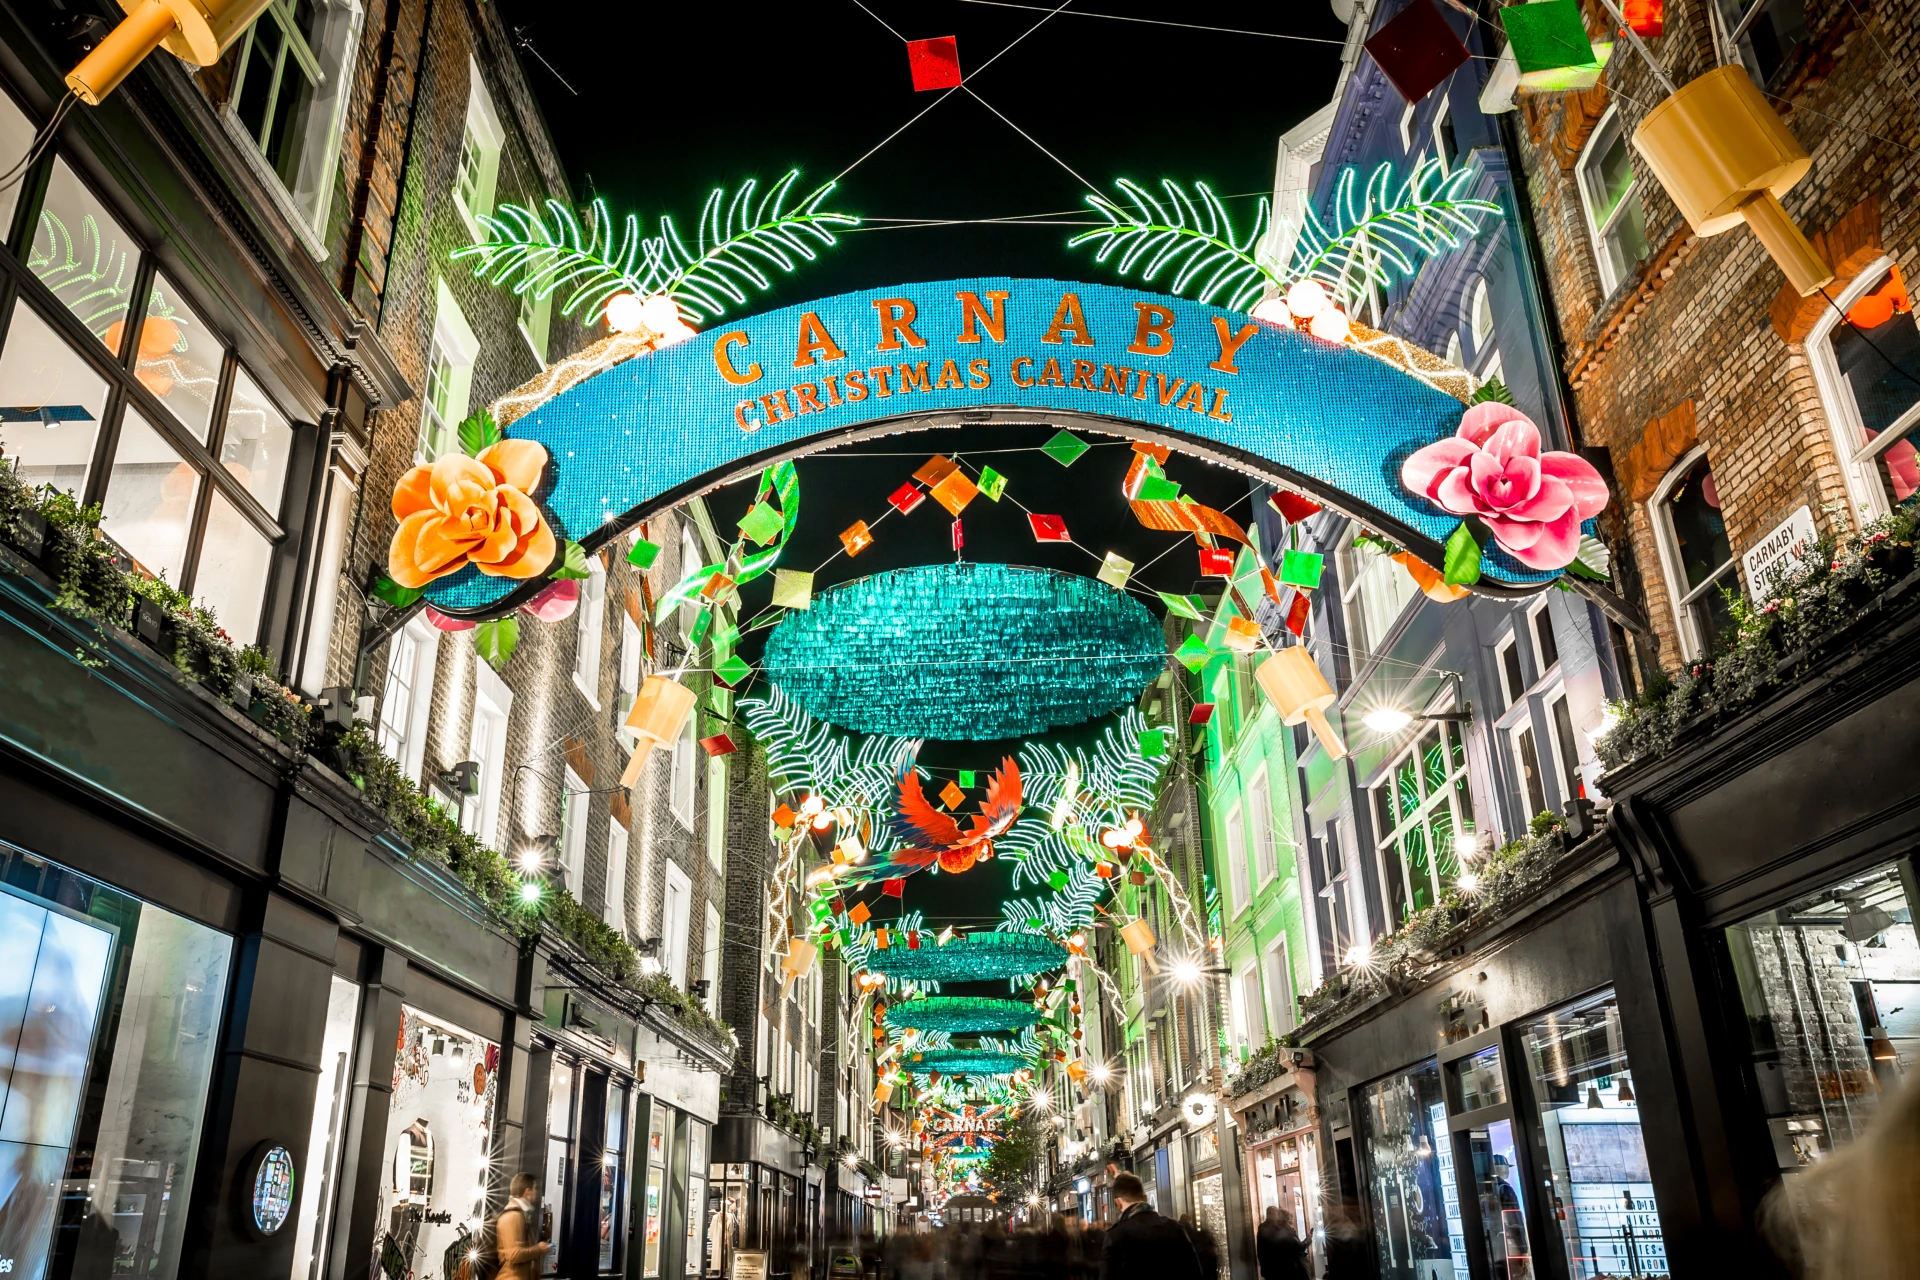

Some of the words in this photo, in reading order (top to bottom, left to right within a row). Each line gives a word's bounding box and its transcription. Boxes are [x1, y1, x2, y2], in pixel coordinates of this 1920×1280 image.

[713, 290, 1260, 386] CARNABY
[734, 358, 991, 432] CHRISTMAS
[1011, 356, 1233, 422] CARNIVAL
[1749, 522, 1795, 572] CARNABY
[1753, 550, 1790, 591] STREET
[933, 1118, 1004, 1132] CARNABY
[1626, 1214, 1650, 1226] NIKE
[1620, 1259, 1666, 1270] PAGON
